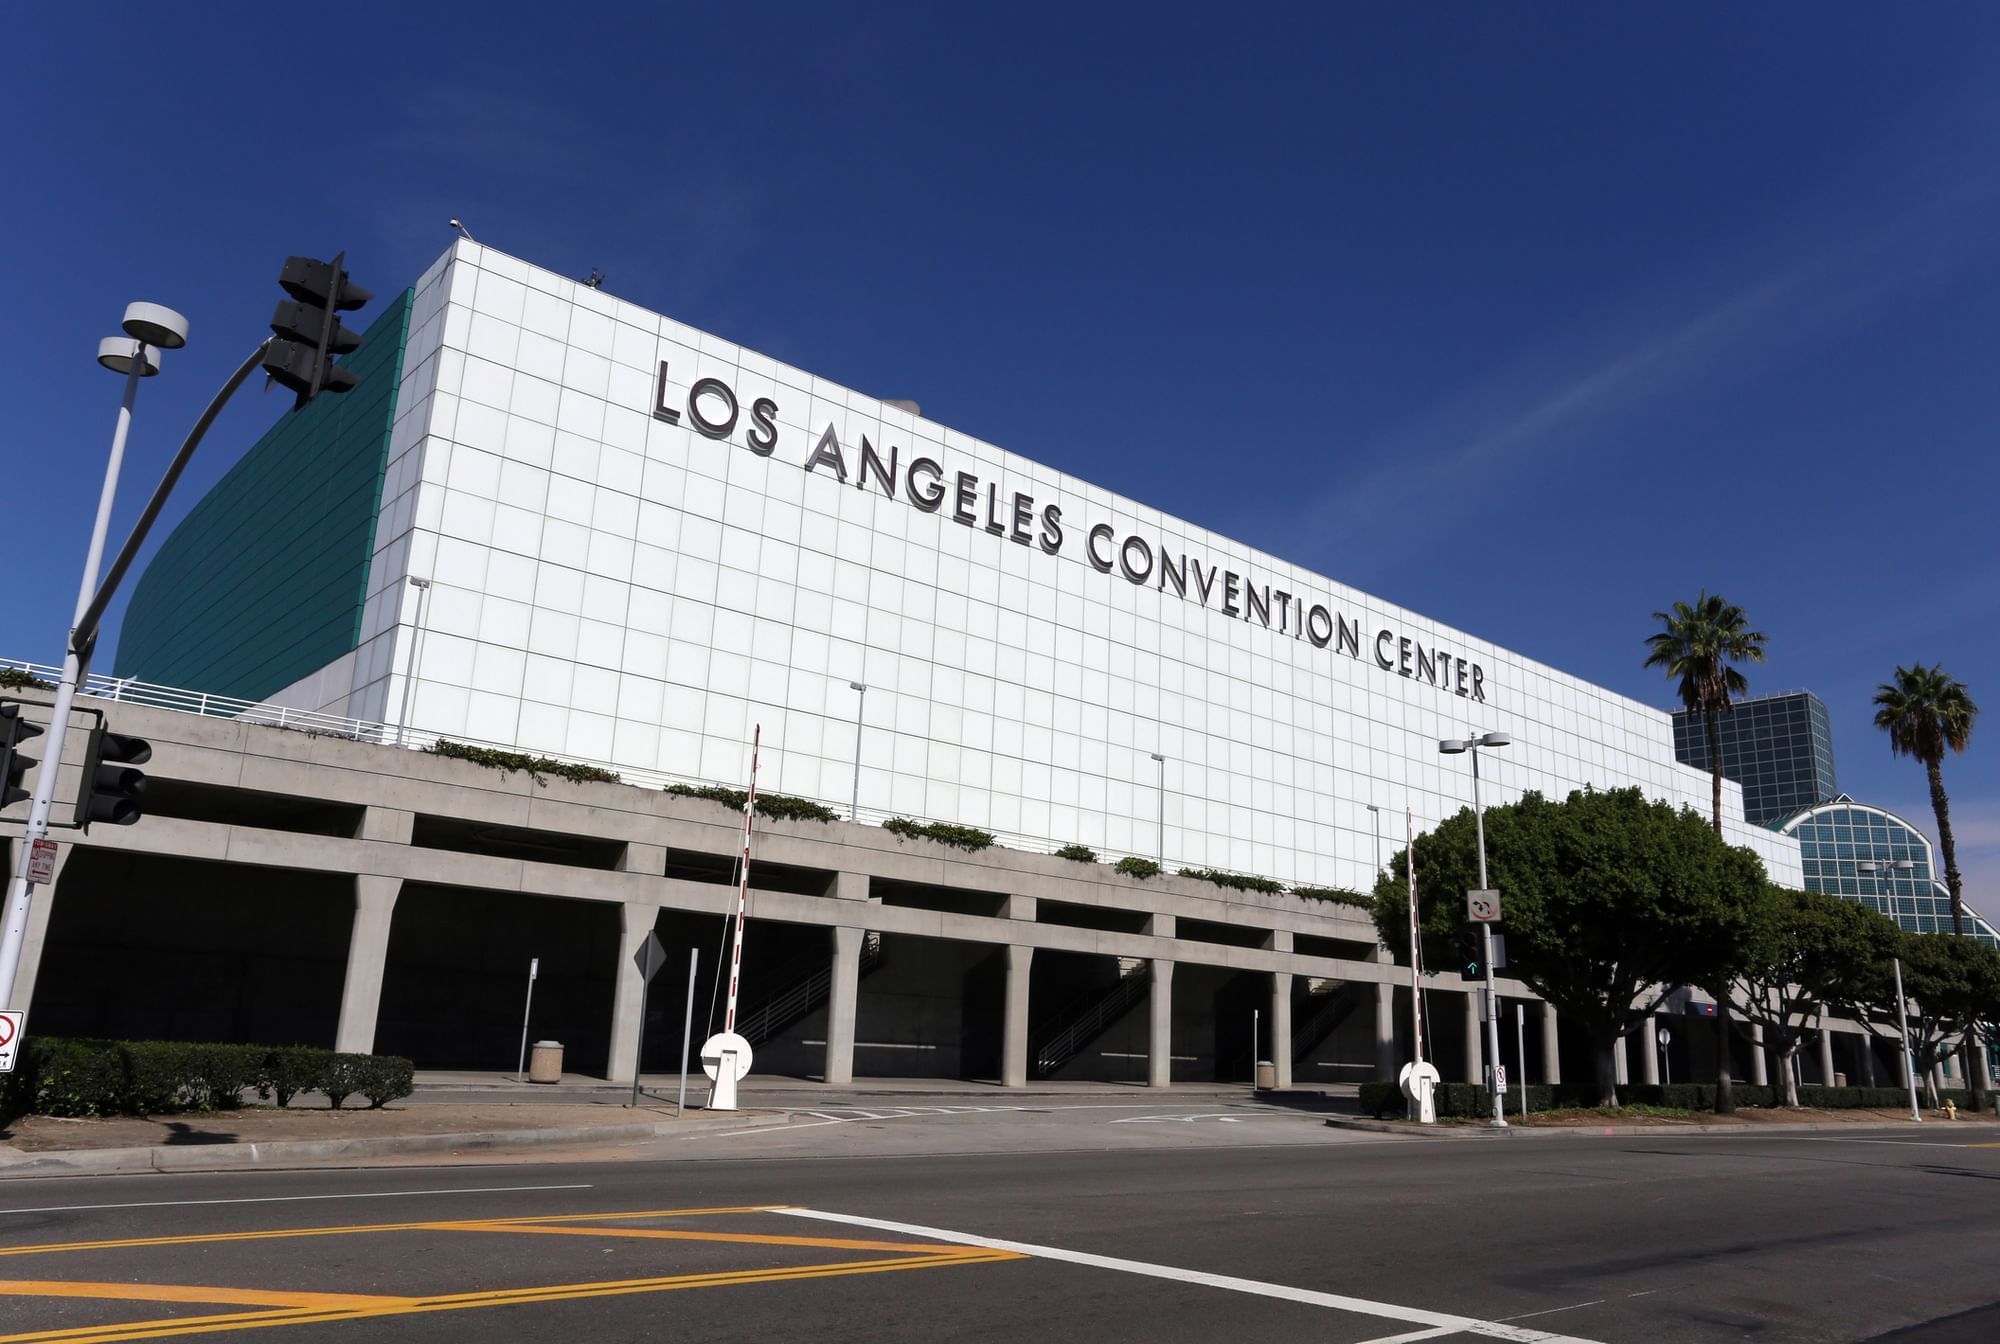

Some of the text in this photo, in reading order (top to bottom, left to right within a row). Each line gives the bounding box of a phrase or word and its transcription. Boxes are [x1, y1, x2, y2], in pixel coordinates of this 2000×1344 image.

[653, 360, 1486, 704] LOS ANGELES CONVENTION CENTER
[32, 861, 52, 871] ANY TIME
